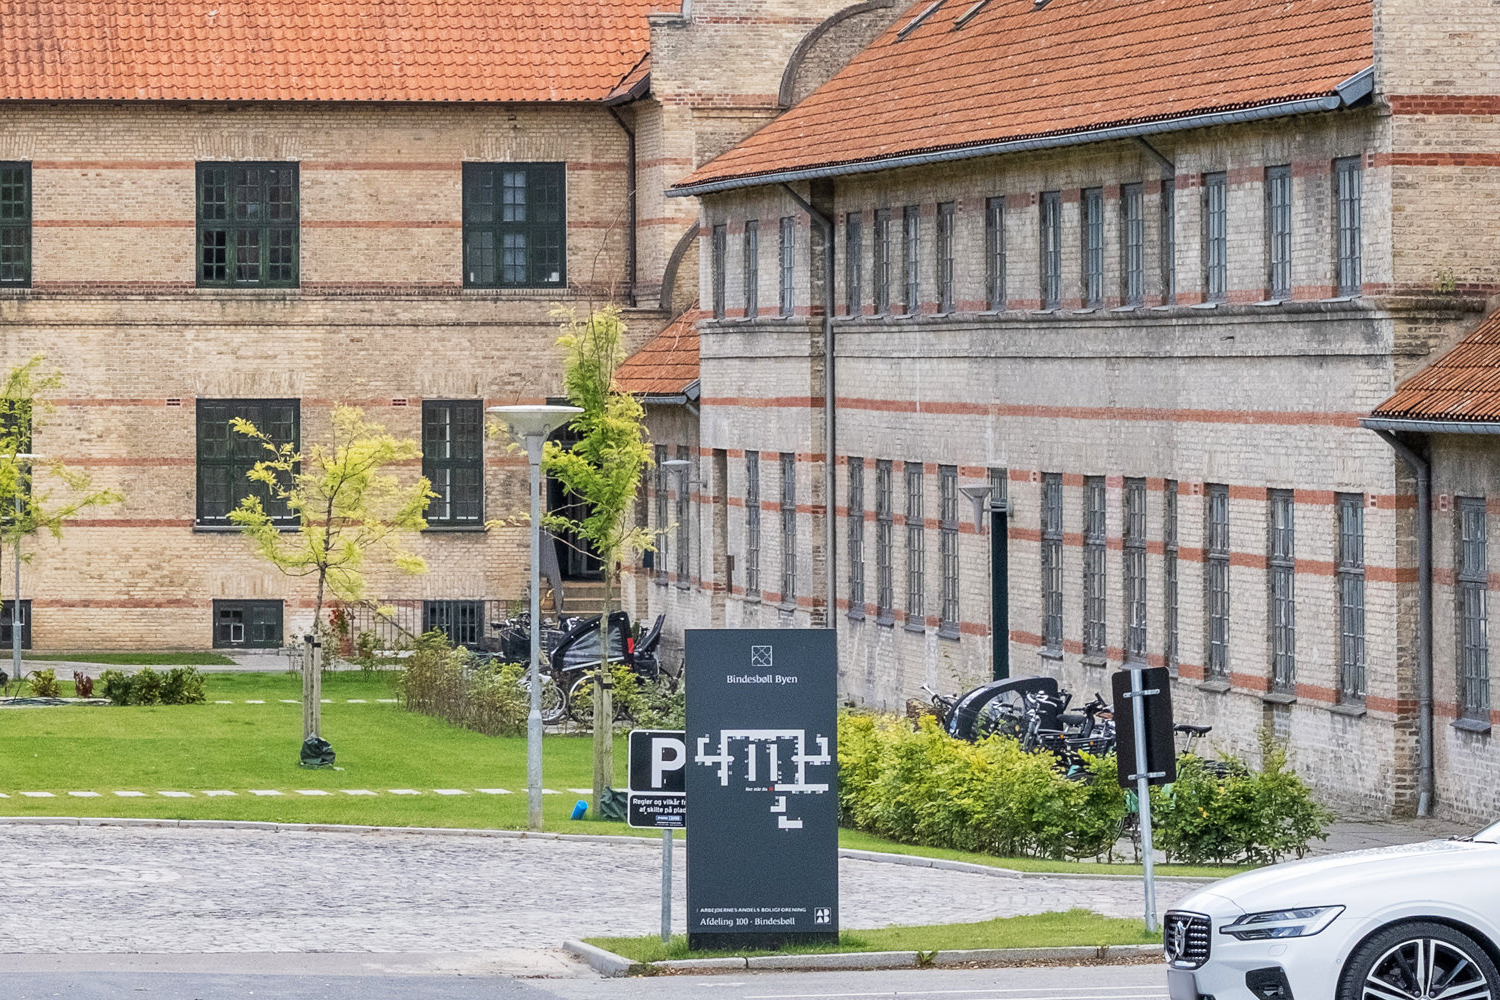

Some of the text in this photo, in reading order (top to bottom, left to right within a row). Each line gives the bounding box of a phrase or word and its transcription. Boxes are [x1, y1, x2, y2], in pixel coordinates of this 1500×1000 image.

[726, 674, 798, 685] Bindesbøll Byen
[651, 737, 686, 788] P
[632, 798, 653, 806] Regler
[664, 806, 673, 814] på
[700, 917, 734, 927] Afdeling
[736, 917, 749, 926] 100
[754, 917, 795, 926] Bindesbøll
